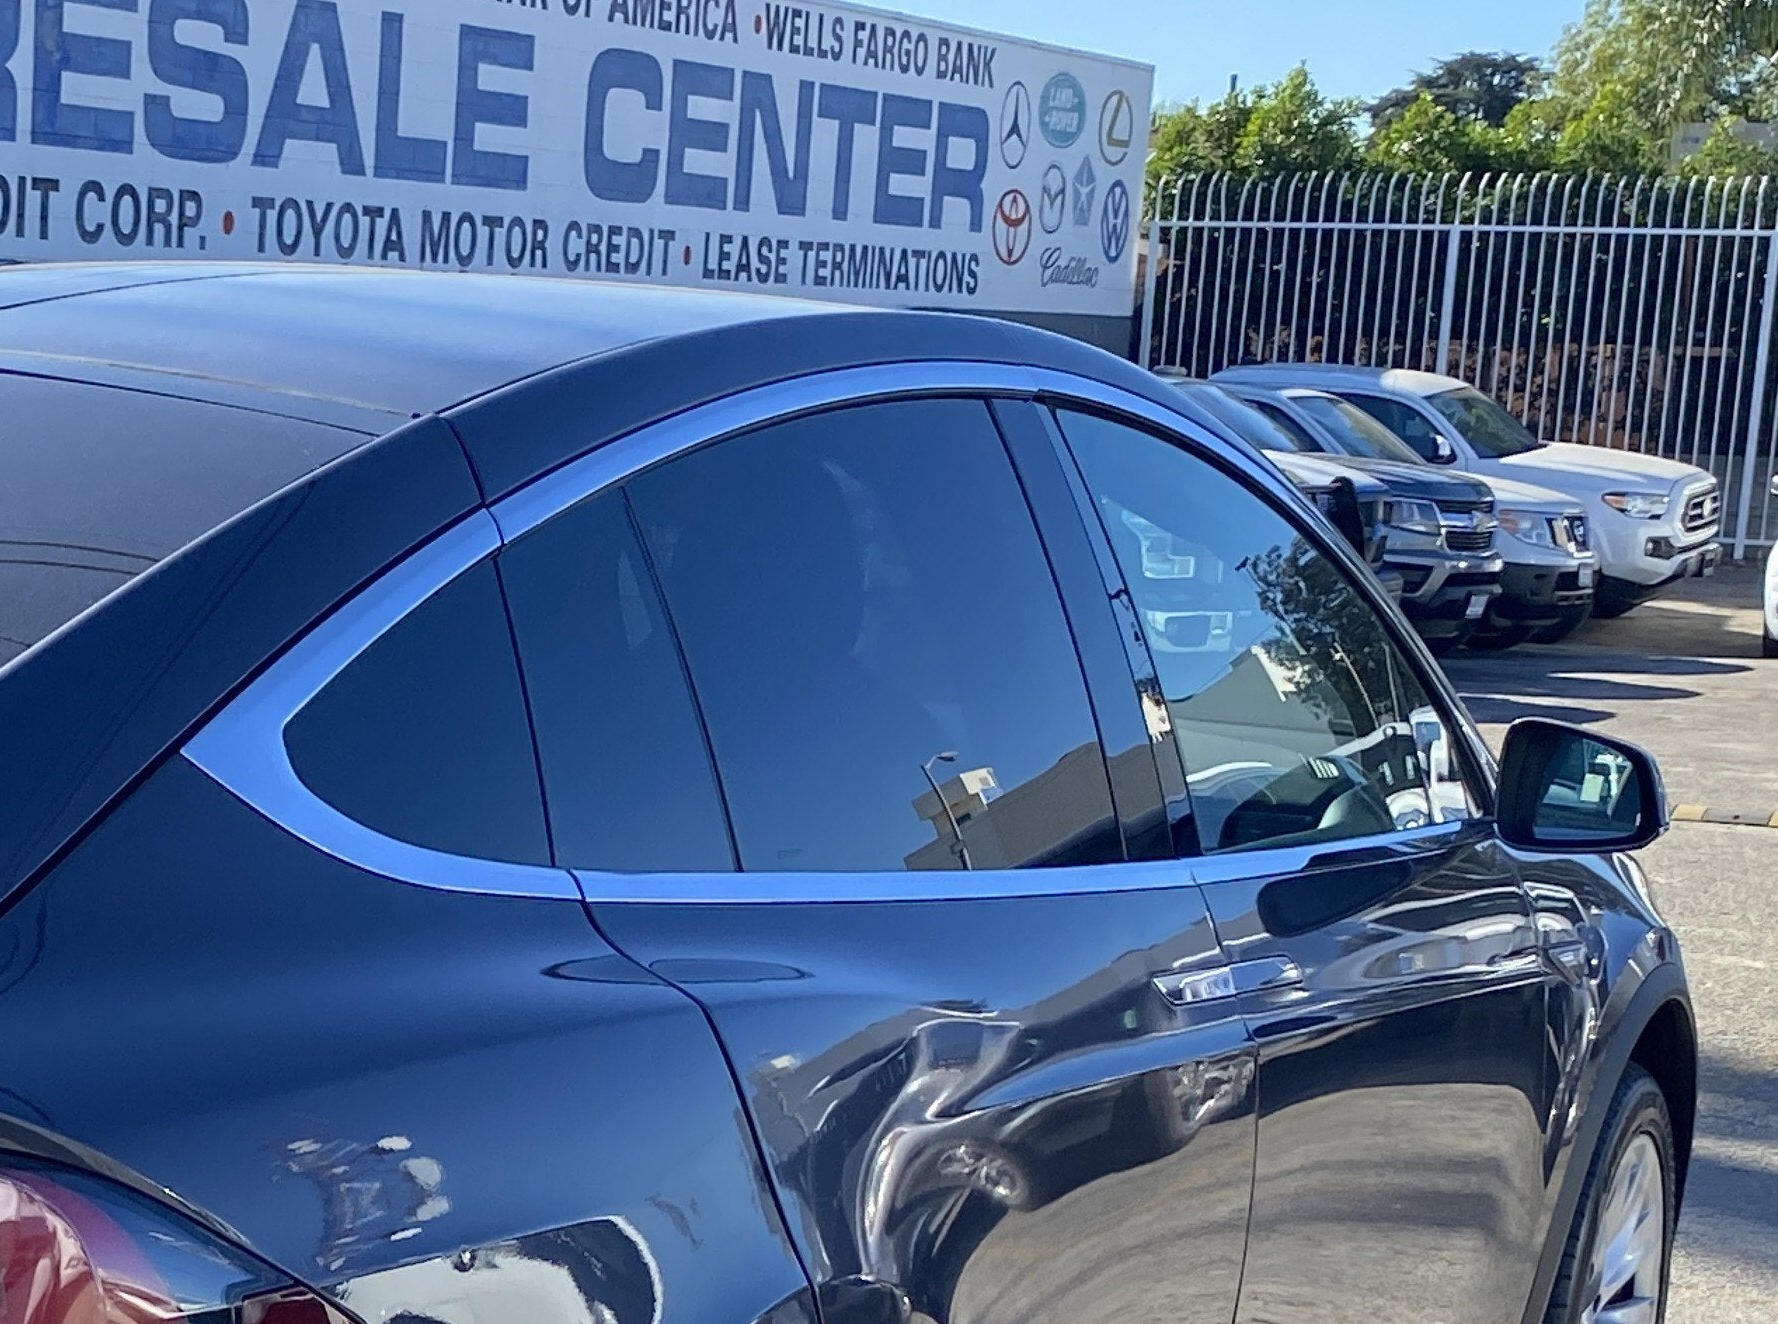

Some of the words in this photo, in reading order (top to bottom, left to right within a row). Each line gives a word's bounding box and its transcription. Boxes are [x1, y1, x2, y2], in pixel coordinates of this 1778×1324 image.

[765, 2, 844, 62] WELLS
[852, 20, 928, 77] FARGO
[936, 37, 997, 89] BANK
[584, 48, 988, 232] CENTER
[75, 179, 207, 250] CORP.
[251, 197, 406, 263] TOYOTA
[421, 209, 549, 270] MOTOR
[562, 221, 677, 276] CREDIT
[701, 231, 789, 284] LEASE
[798, 239, 981, 296] TERMINATIONS
[1039, 247, 1100, 288] Cadillac
